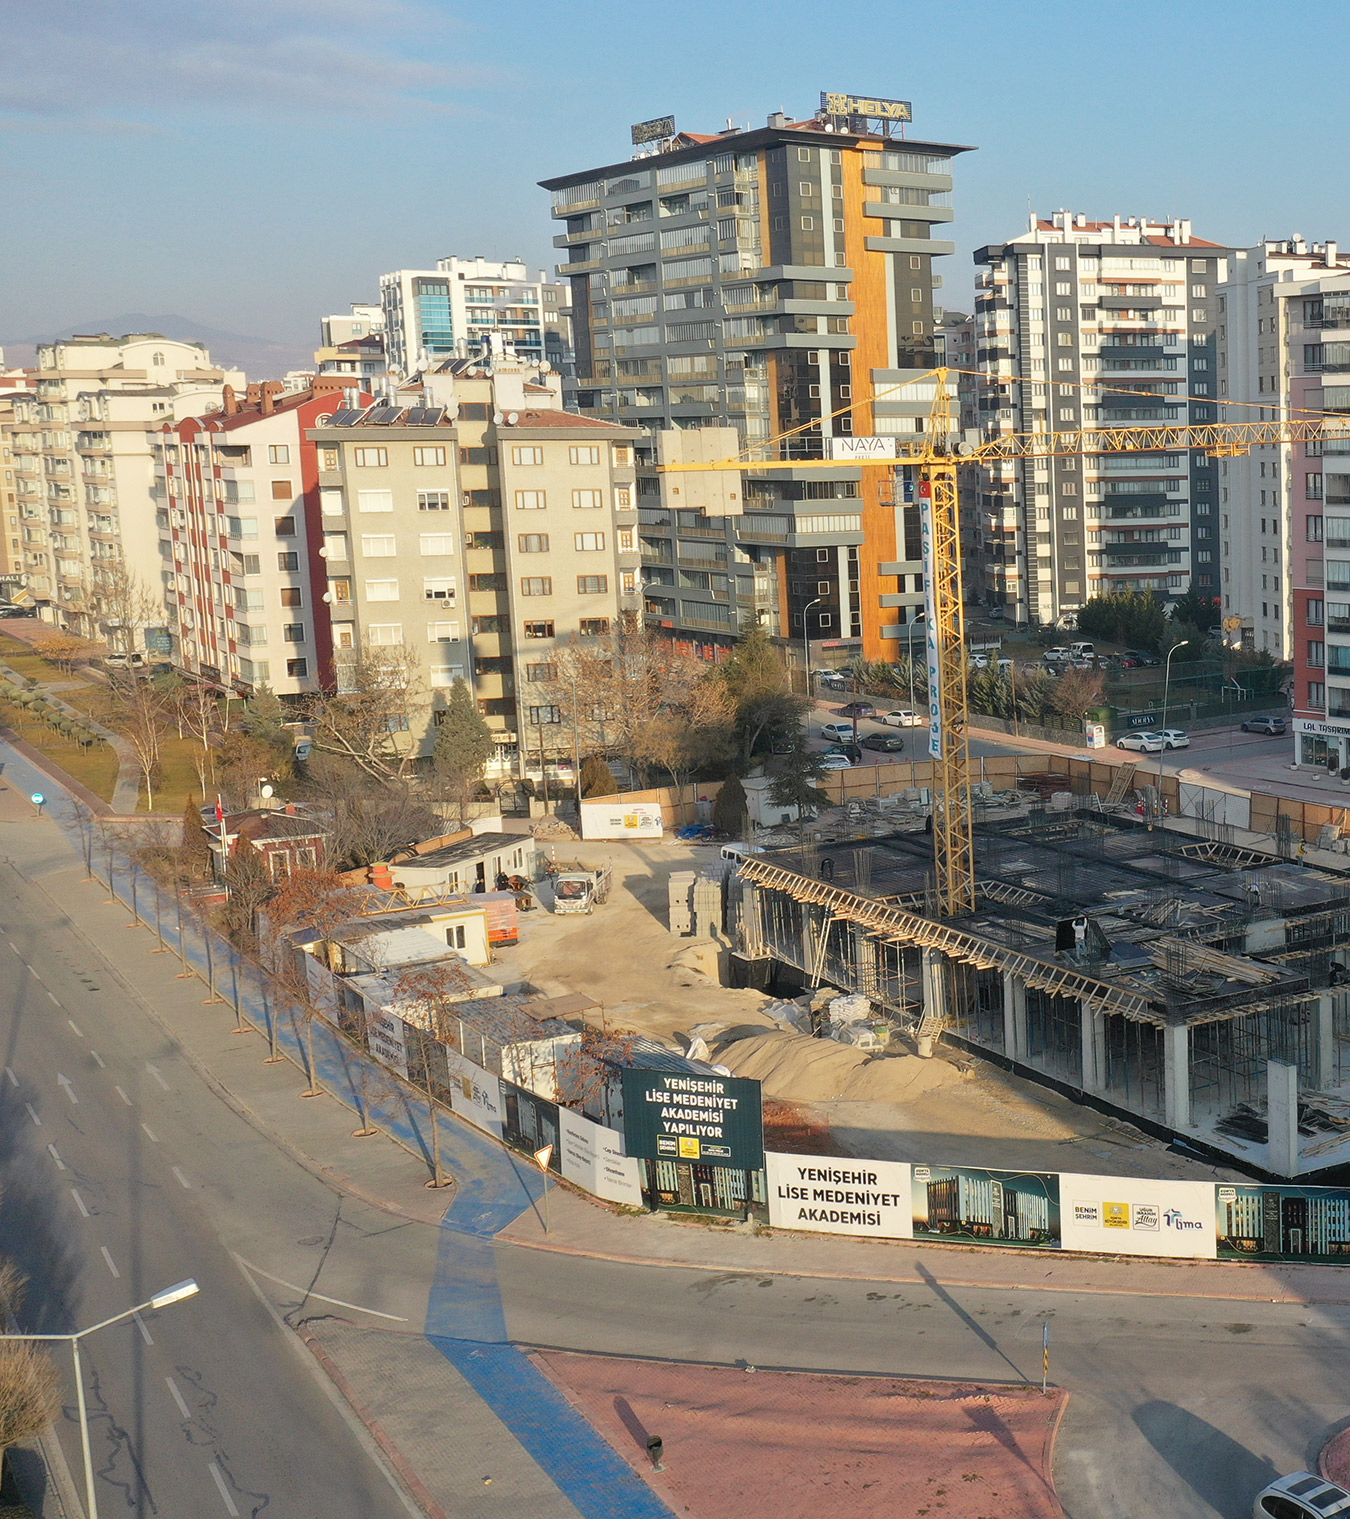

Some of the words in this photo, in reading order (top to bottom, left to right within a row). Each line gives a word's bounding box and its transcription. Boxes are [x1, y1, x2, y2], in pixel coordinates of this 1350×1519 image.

[849, 98, 911, 118] HELYA
[842, 438, 885, 451] NAYA
[929, 667, 939, 752] PROJE
[1303, 722, 1316, 731] LAL
[1319, 724, 1350, 735] TASARIM
[664, 1077, 724, 1094] YENİŞEHİR
[645, 1089, 671, 1103] LİSE
[673, 1093, 738, 1110] MEDENİYET
[661, 1107, 723, 1123] AKADEMİSİ
[663, 1122, 723, 1138] YAPILIYOR
[798, 1167, 878, 1185] YENİŞEHİR
[778, 1184, 808, 1200] LİSE
[813, 1189, 900, 1207] MEDENİYET
[798, 1208, 881, 1226] AKADEMİSİ
